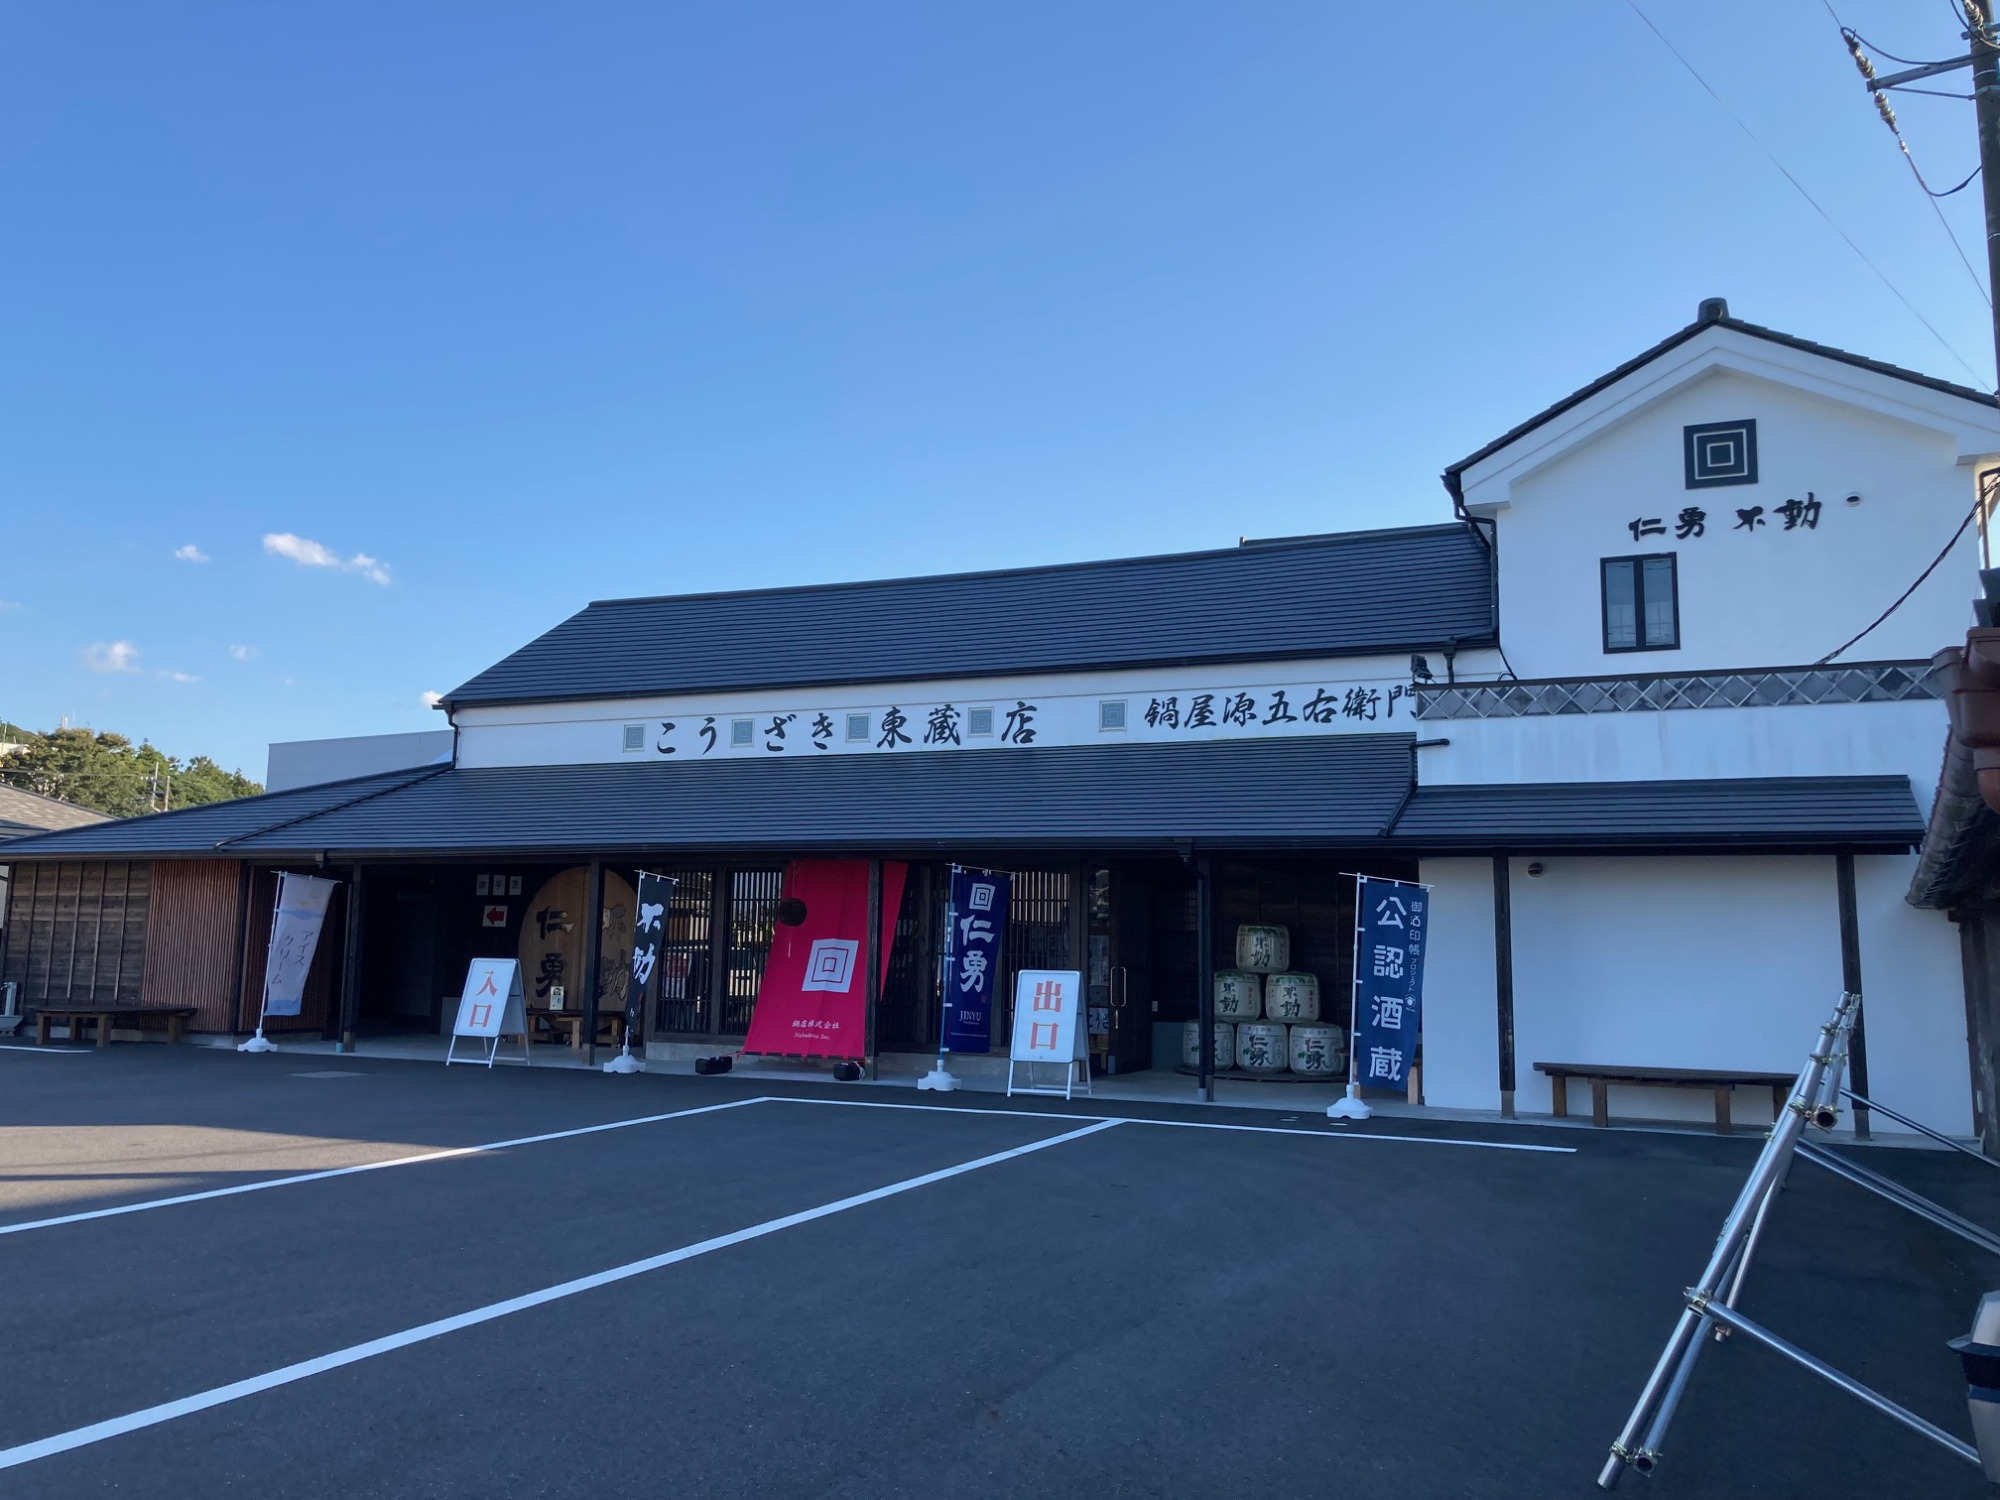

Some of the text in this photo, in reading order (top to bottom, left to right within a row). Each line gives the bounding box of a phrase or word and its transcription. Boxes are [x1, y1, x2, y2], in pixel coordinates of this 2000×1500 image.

[271, 935, 293, 984] クリーム
[294, 930, 314, 966] アイス
[536, 907, 574, 998] 仁勇
[960, 914, 995, 992] 仁勇
[469, 971, 498, 1028] 入口
[958, 1010, 982, 1022] JINYU
[1031, 980, 1062, 1050] 出口
[1369, 896, 1407, 1081] 公認酒蔵
